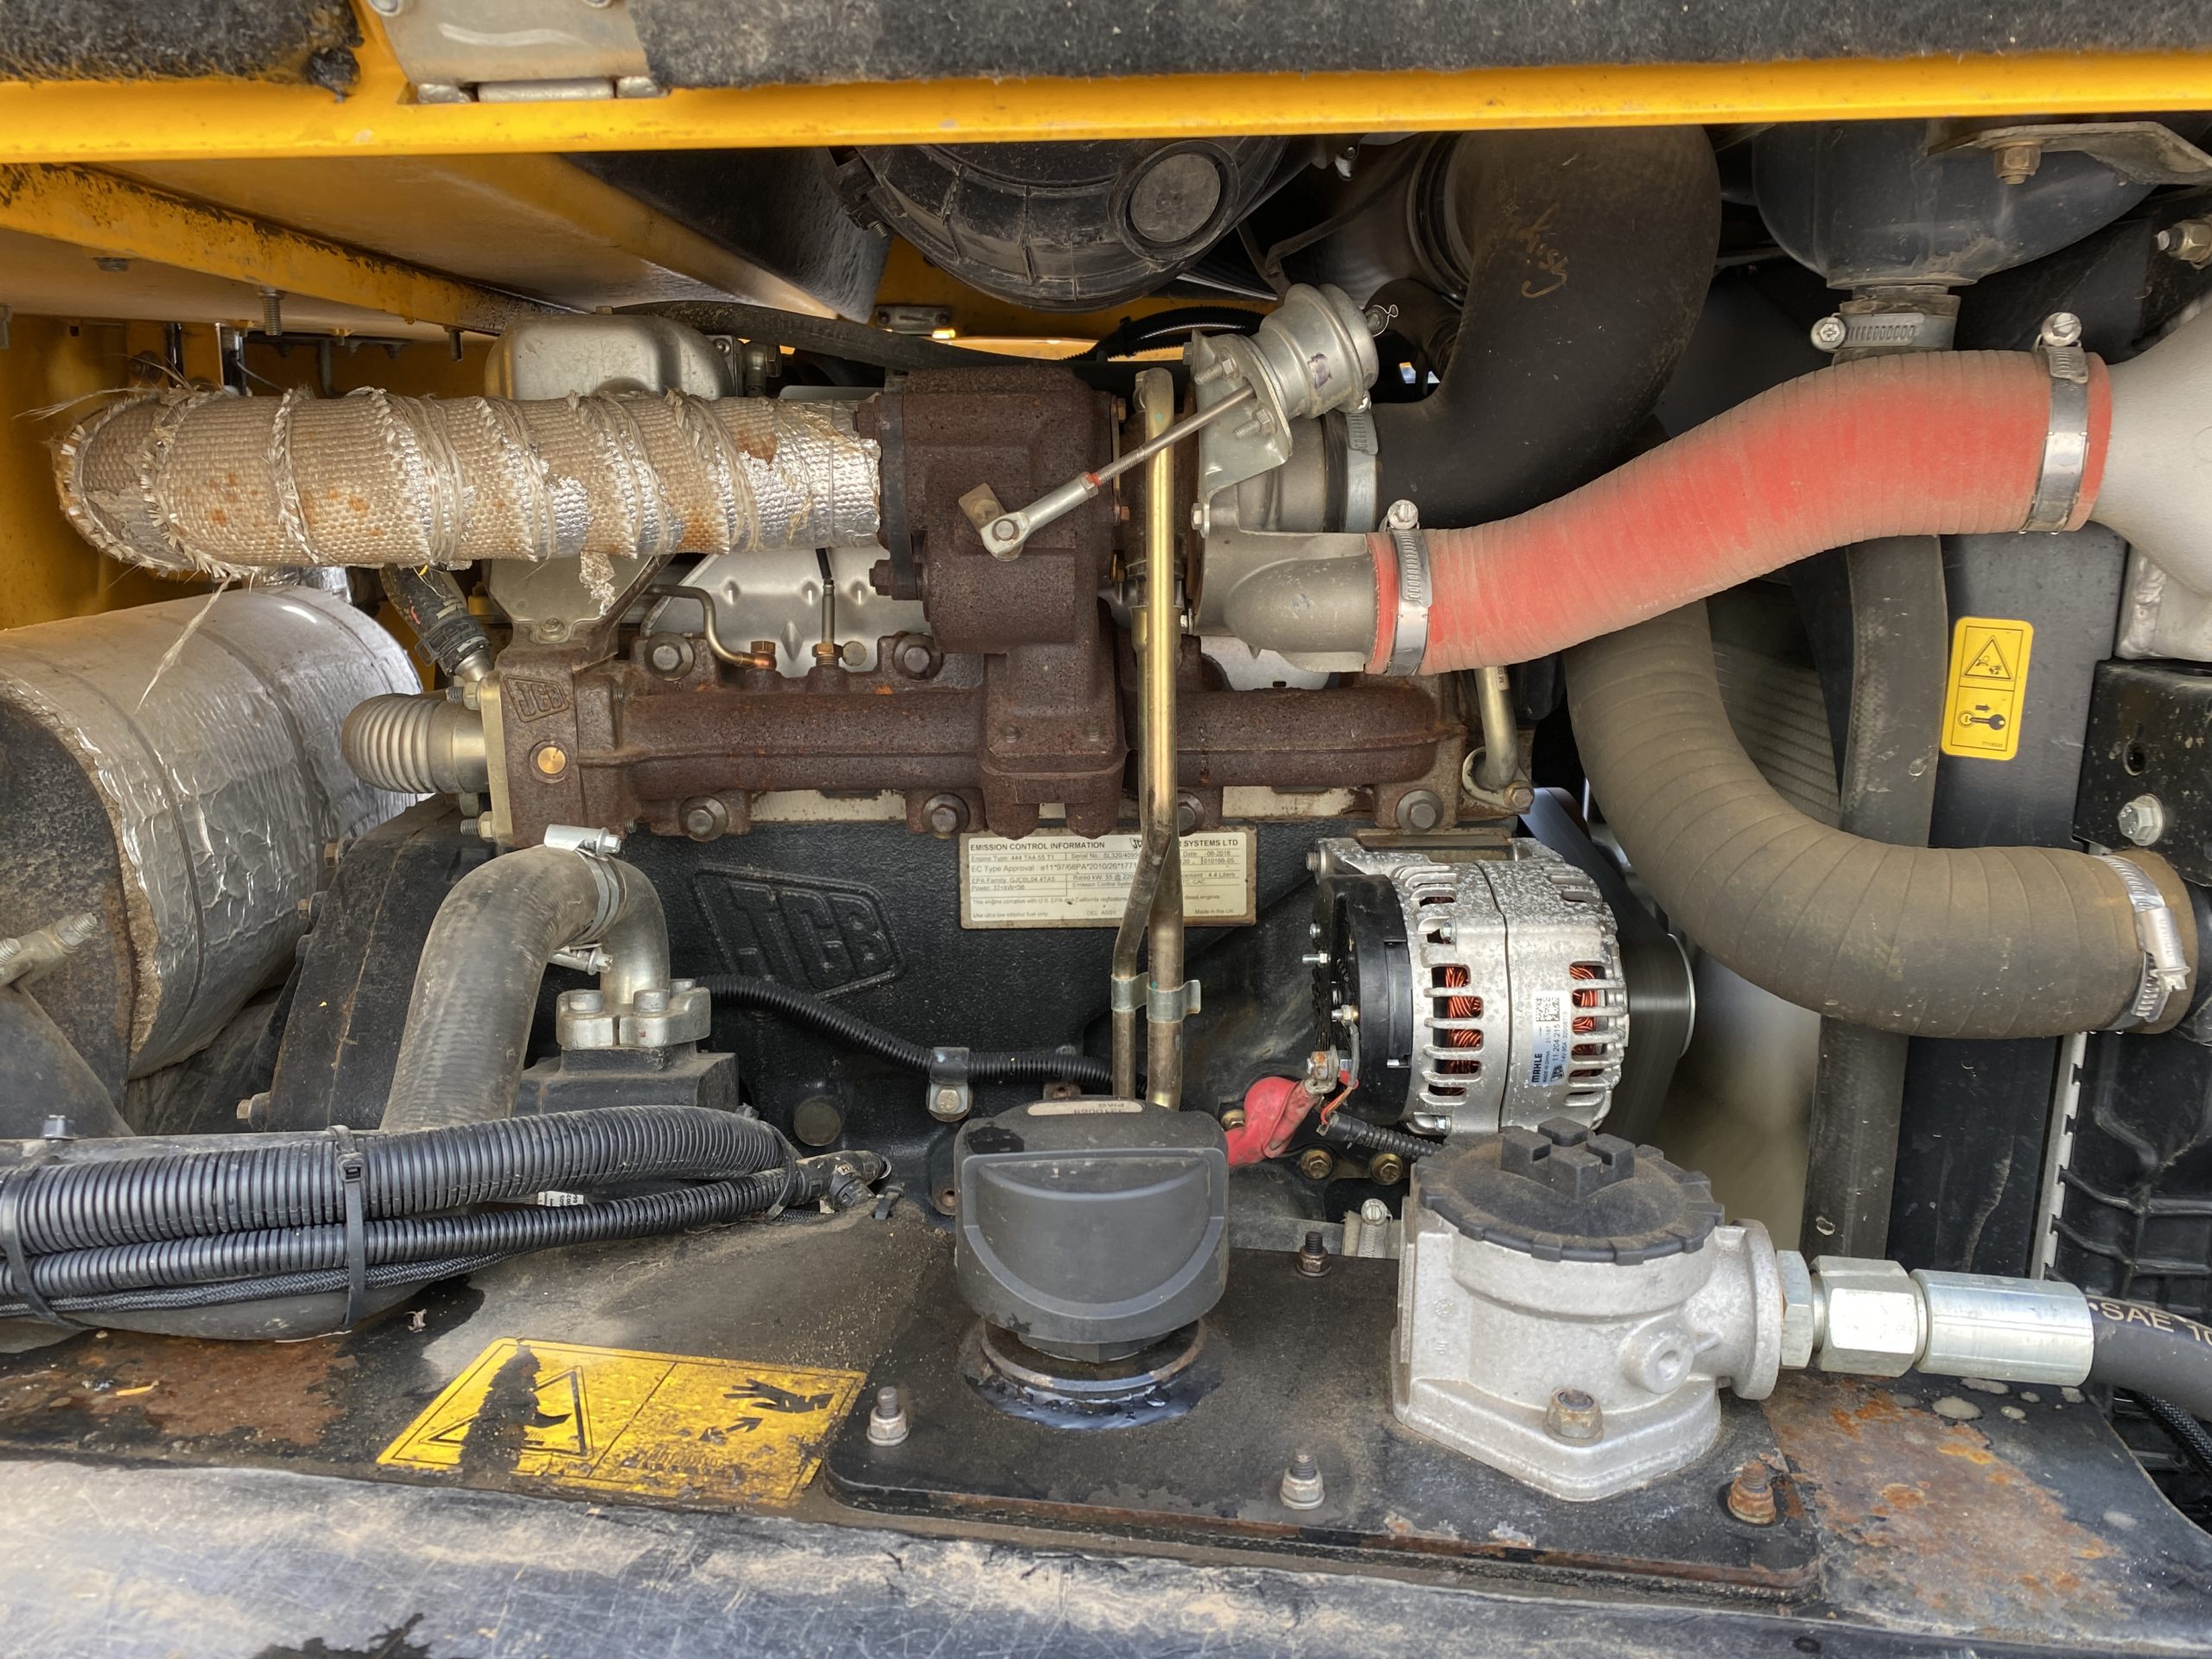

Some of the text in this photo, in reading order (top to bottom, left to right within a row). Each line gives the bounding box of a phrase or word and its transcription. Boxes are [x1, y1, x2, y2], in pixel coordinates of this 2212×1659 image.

[516, 681, 563, 716] JCB
[1531, 1053, 1542, 1083] MAHLE
[2101, 1301, 2174, 1332] SAE
